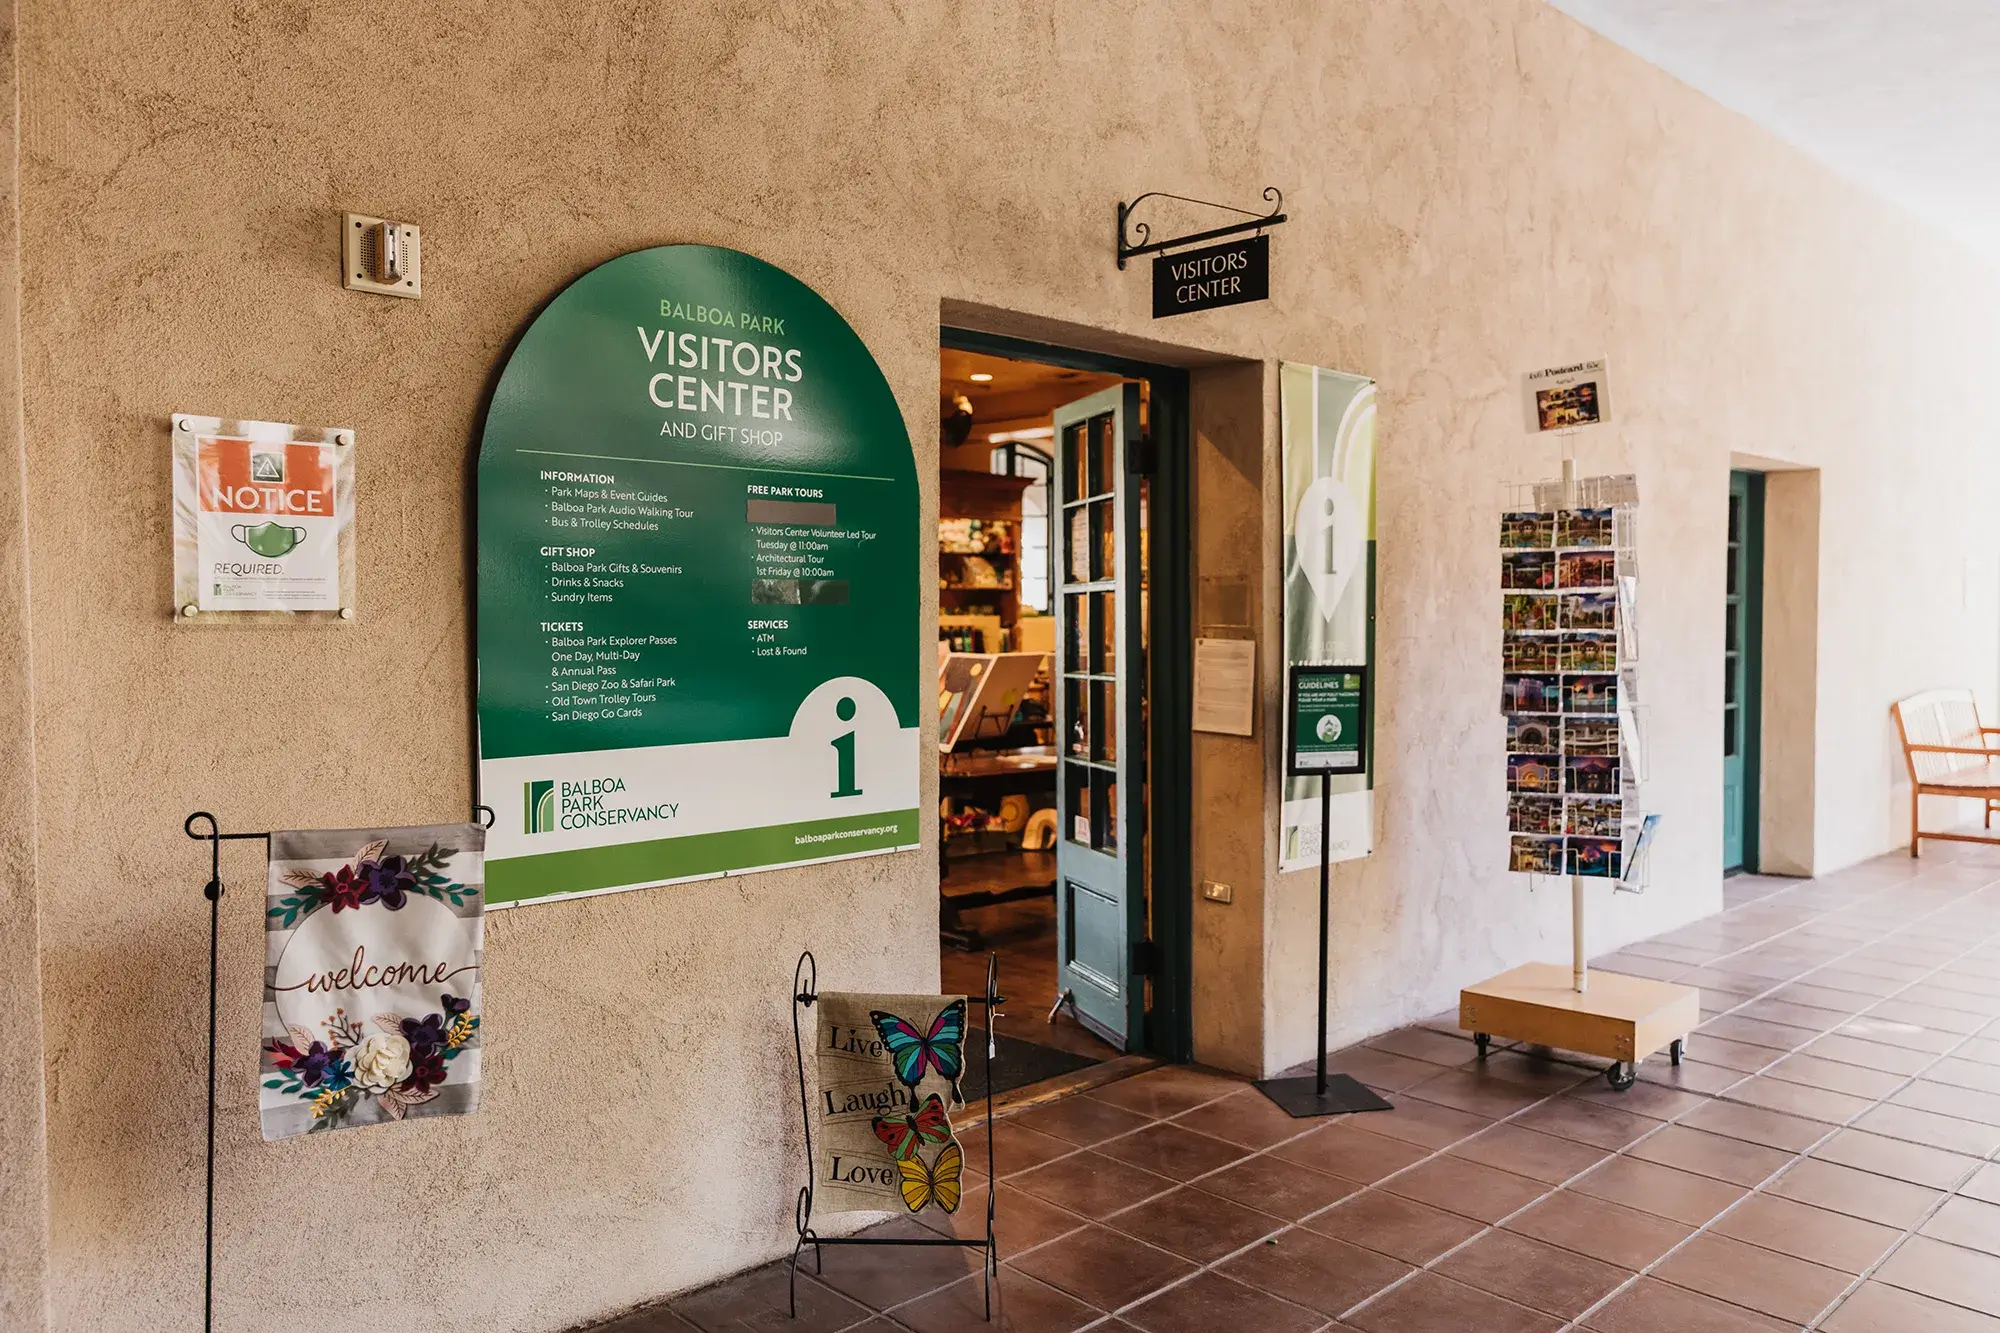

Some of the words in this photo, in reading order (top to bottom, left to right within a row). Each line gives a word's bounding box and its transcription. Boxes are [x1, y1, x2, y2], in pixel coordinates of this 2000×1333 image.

[1171, 250, 1248, 281] VISITORS
[1176, 276, 1241, 304] CENTER
[660, 299, 735, 328] BALBOA
[740, 313, 786, 336] PARK
[636, 326, 803, 383] VISITORS
[648, 372, 793, 421] CENTER
[660, 421, 697, 439] AND
[701, 424, 737, 442] GIFT
[740, 428, 783, 447] SHOP
[540, 471, 615, 484] INFORMATION
[212, 485, 323, 513] NOTICE
[551, 487, 572, 497] Park
[574, 489, 599, 500] Maps
[600, 490, 608, 499] &
[610, 490, 636, 501] Event
[637, 492, 668, 503] Guides
[747, 485, 769, 495] FREE
[770, 486, 793, 496] PARK
[795, 488, 824, 498] TOURS
[551, 502, 584, 512] Balboa
[586, 503, 607, 513] Park
[608, 505, 636, 515] Audio
[638, 507, 673, 519] Walking
[674, 508, 694, 518] Tour
[551, 517, 569, 527] Bus
[570, 518, 578, 527] &
[580, 517, 611, 531] Trolley
[613, 520, 659, 531] Schedules
[756, 526, 784, 536] Visitors
[785, 527, 810, 537] Center
[811, 528, 846, 539] Volunteer
[846, 530, 860, 539] Led
[861, 530, 877, 540] Tour
[540, 547, 564, 557] GIFT
[566, 547, 596, 558] SHOP
[756, 539, 788, 551] Tuesday
[790, 542, 797, 551] @
[798, 541, 829, 551] 11:00am
[756, 553, 806, 563] Architectural
[807, 554, 825, 564] Tour
[213, 562, 285, 577] REQUIRED.
[551, 562, 584, 572] Balboa
[586, 563, 607, 573] Park
[609, 563, 630, 573] Gifts
[631, 564, 639, 573] &
[640, 564, 683, 574] Souvenirs
[756, 566, 766, 576] 1st
[768, 566, 791, 578] Friday
[793, 568, 800, 578] @
[801, 567, 835, 577] 10:00am
[551, 577, 582, 587] Drinks
[583, 578, 591, 587] &
[592, 577, 624, 588] Snacks
[551, 592, 585, 604] Sundry
[587, 592, 613, 602] Items
[540, 622, 584, 632] TICKETS
[747, 620, 789, 629] SERVICES
[551, 637, 585, 647] Balboa
[586, 636, 607, 646] Park
[609, 636, 647, 647] Explorer
[649, 635, 677, 645] Passes
[756, 633, 775, 643] ATM
[551, 652, 573, 662] One
[574, 651, 594, 663] Day,
[596, 650, 640, 662] Multi-Day
[757, 646, 774, 656] Lost
[775, 647, 781, 656] &
[782, 646, 808, 656] Found
[551, 667, 559, 677] &
[560, 666, 595, 676] Annual
[596, 665, 617, 675] Pass
[551, 682, 569, 692] San
[571, 681, 599, 693] Diego
[601, 680, 620, 690] Zoo
[621, 679, 628, 689] &
[629, 678, 655, 688] Safari
[656, 677, 676, 687] Park
[1298, 681, 1339, 689] GUIDELINES
[552, 696, 570, 707] Old
[572, 695, 597, 705] Town
[599, 693, 631, 706] Trolley
[632, 692, 656, 702] Tours
[552, 711, 569, 722] San
[572, 710, 600, 721] Diego
[601, 709, 615, 719] Go
[616, 708, 643, 718] Cards
[830, 696, 863, 799] i
[561, 777, 627, 798] BALBOA
[561, 794, 604, 814] PARK
[560, 803, 680, 830] CONSERVANCY
[794, 824, 898, 845] balboaparkconservancy.org
[266, 945, 481, 993] welcome
[828, 1025, 883, 1058] Live
[823, 1081, 909, 1117] Laugh
[829, 1156, 893, 1186] Love
